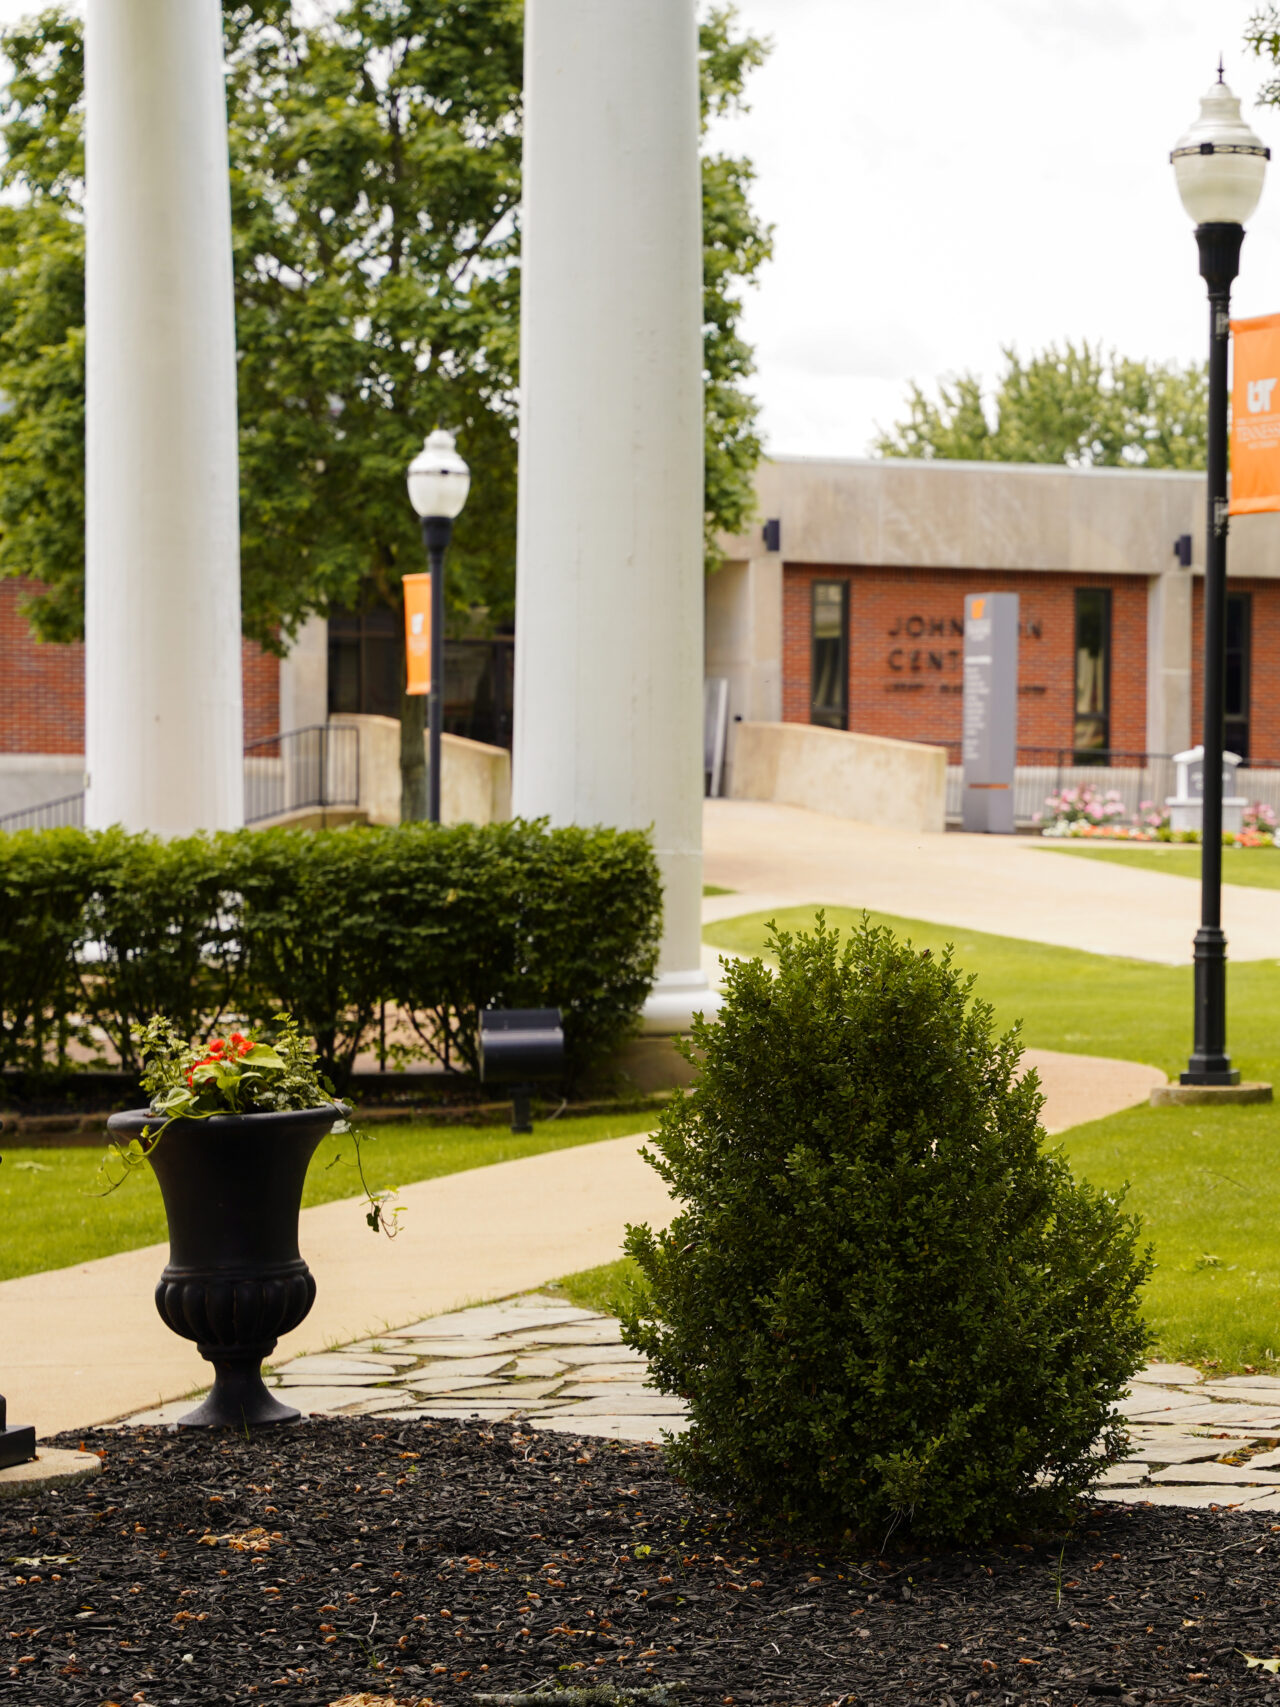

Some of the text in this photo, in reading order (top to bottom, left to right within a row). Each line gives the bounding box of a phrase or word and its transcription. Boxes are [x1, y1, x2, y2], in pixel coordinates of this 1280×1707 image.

[1247, 378, 1277, 413] UT
[888, 615, 1043, 640] JOHNN
[888, 648, 961, 672] CENT
